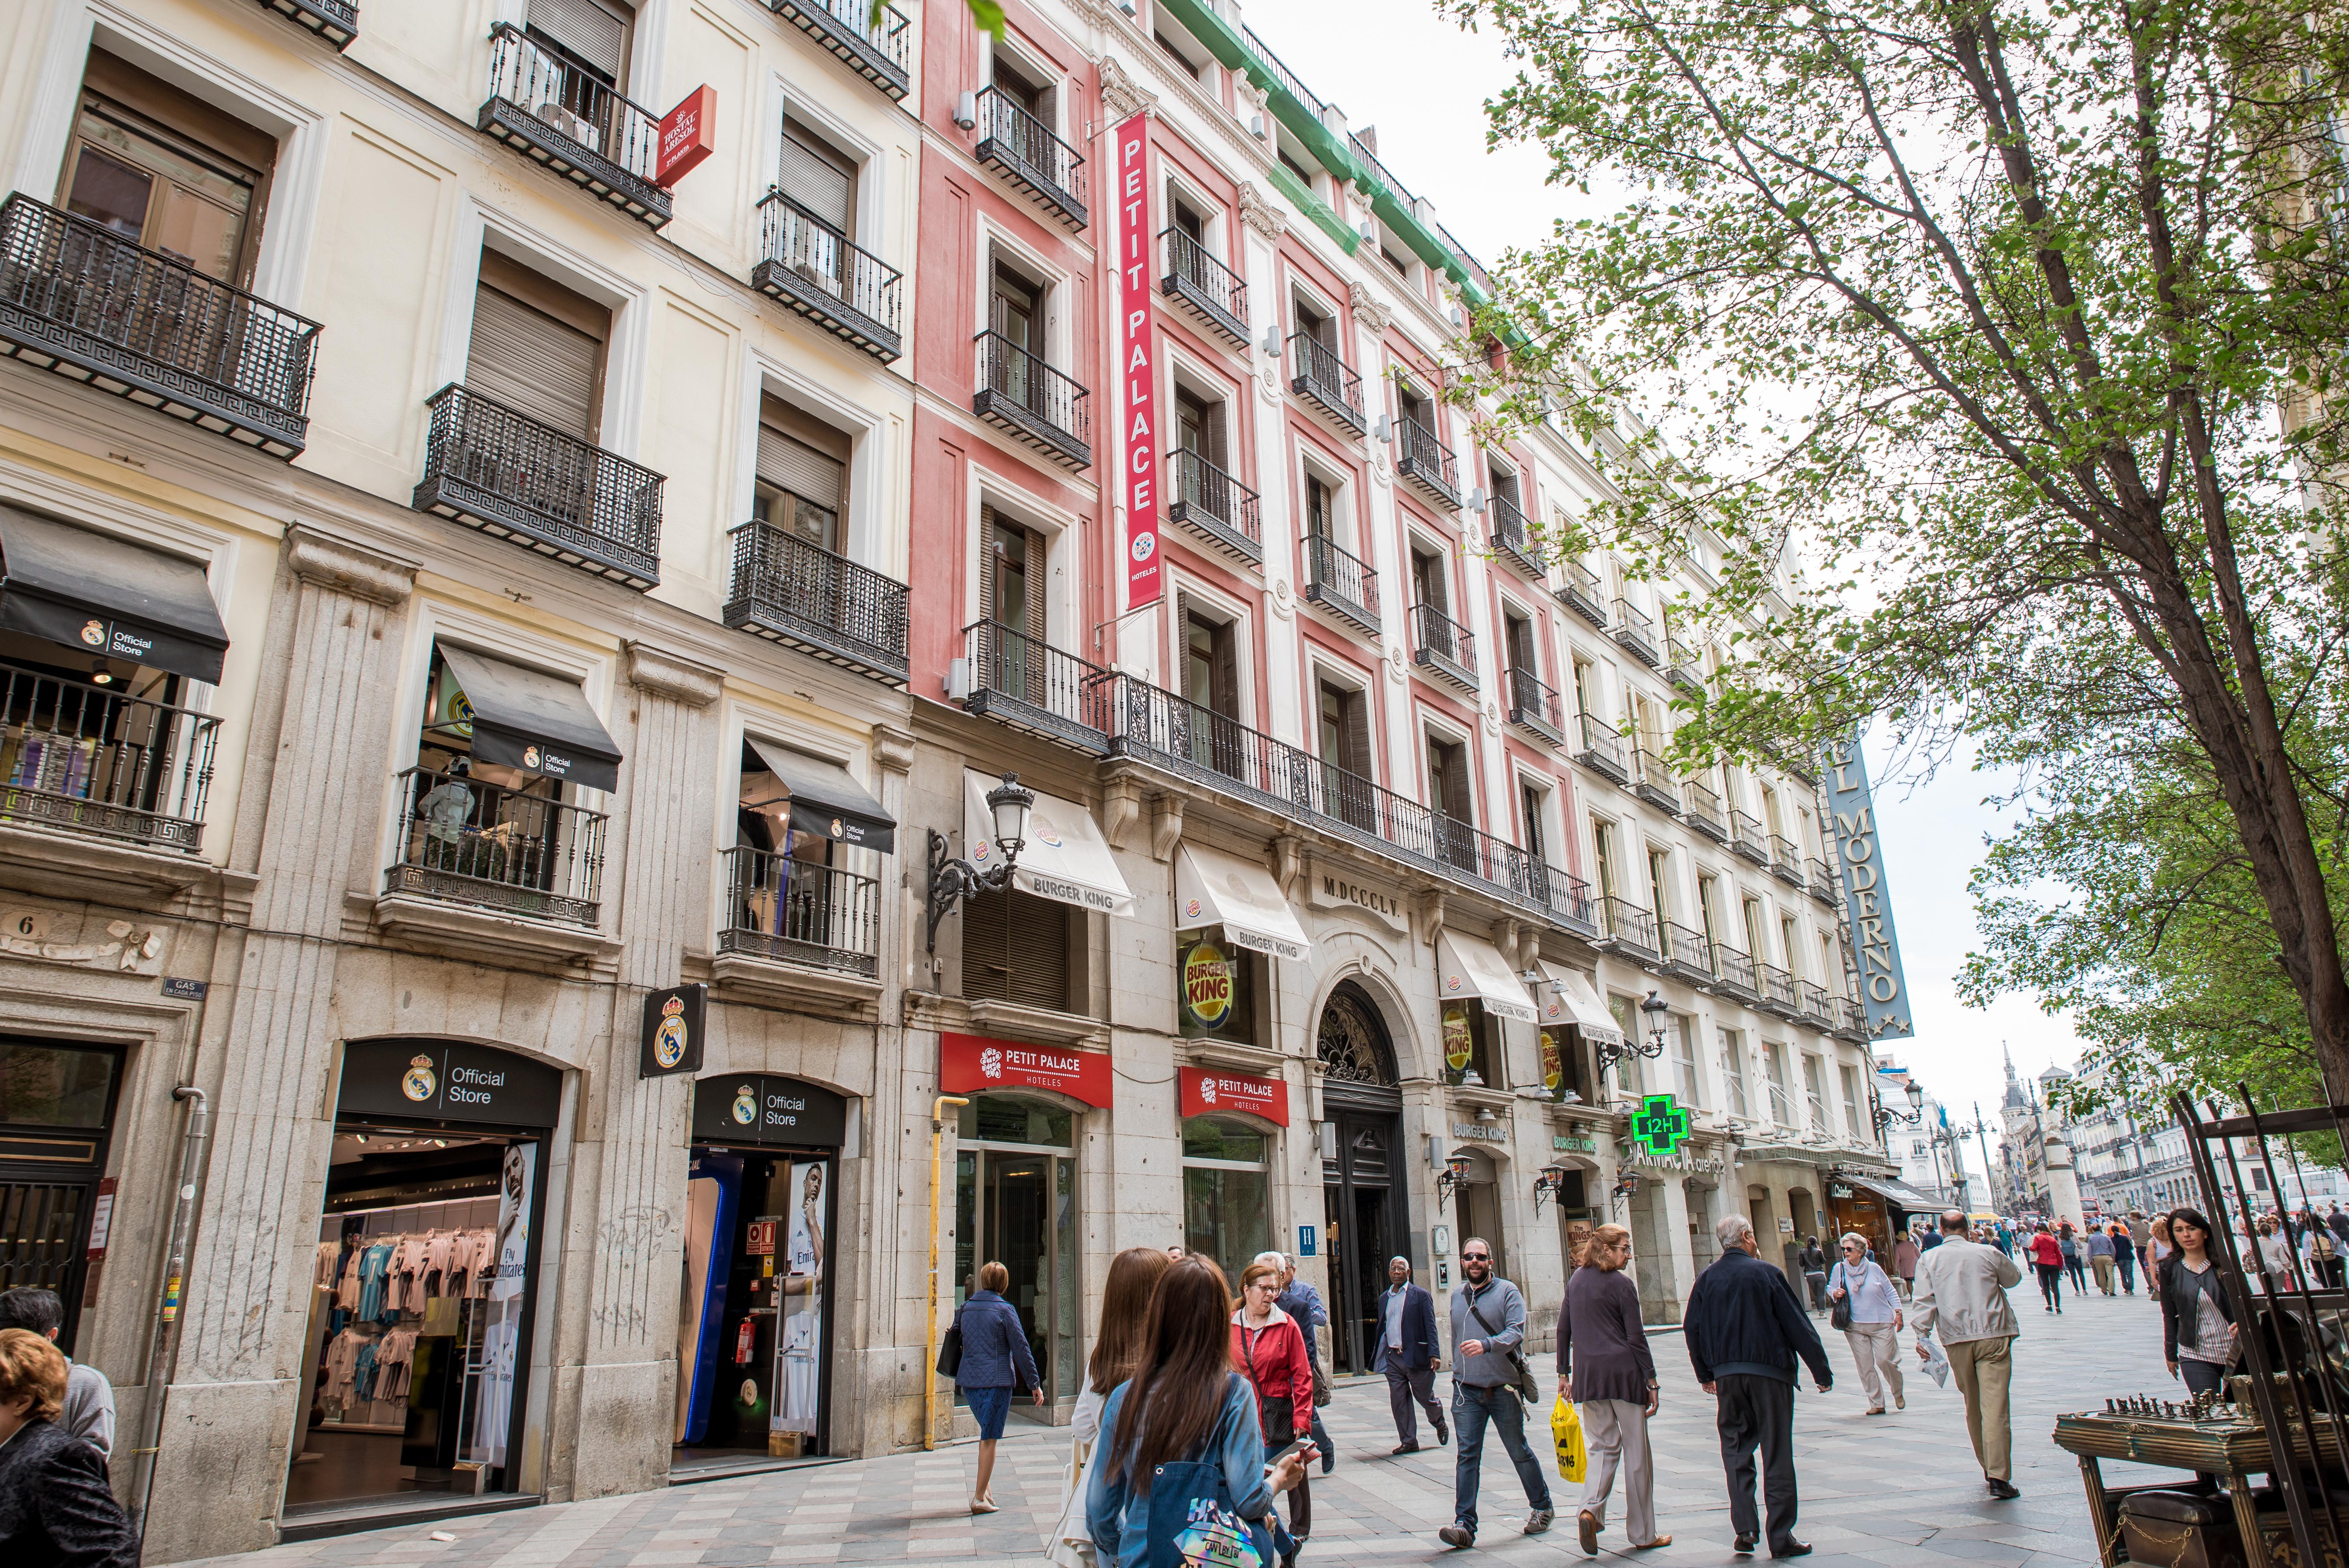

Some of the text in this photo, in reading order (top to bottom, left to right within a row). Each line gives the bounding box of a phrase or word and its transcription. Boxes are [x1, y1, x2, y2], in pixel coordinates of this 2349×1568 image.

[665, 114, 696, 145] HOSTAL
[664, 124, 696, 155] ARESOL
[671, 144, 690, 163] PLANTA
[1125, 139, 1150, 511] PETIT PALACE
[1132, 566, 1157, 581] HOTELES
[113, 641, 142, 656] Store
[114, 632, 152, 649] Official
[545, 755, 571, 767] Official
[545, 763, 565, 774] Store
[846, 825, 864, 835] Official
[846, 832, 861, 841] Store
[1037, 829, 1058, 839] KING
[975, 842, 987, 853] BURGER
[975, 848, 988, 858] KING
[1829, 739, 1897, 1002] EL MODERNO
[1034, 877, 1113, 909] BURGER KING
[1187, 901, 1199, 910] BURGER
[1188, 905, 1200, 914] KING
[19, 916, 33, 934] 6
[1239, 931, 1297, 957] BURGER KING
[1187, 962, 1227, 983] BURGER
[176, 981, 195, 990] GAS
[1188, 978, 1228, 1006] KING
[1449, 980, 1460, 988] KING
[1492, 1003, 1529, 1019] BURGER KING
[1587, 1027, 1616, 1042] BURGER KING
[1444, 1036, 1469, 1056] KING
[1006, 1050, 1080, 1071] PETIT PALACE
[1544, 1057, 1560, 1077] ING
[452, 1067, 504, 1086] Official
[1027, 1076, 1061, 1087] HOTELES
[449, 1086, 491, 1104] Store
[1219, 1079, 1272, 1097] PETIT PALACE
[767, 1095, 805, 1110] Official
[1234, 1101, 1259, 1110] HOTELES
[766, 1111, 796, 1125] Store
[1646, 1117, 1673, 1133] 12H
[1454, 1123, 1507, 1141] BURGER KING
[1553, 1136, 1597, 1152] BURGER KING
[1629, 1142, 1695, 1171] ARMACIA
[1835, 1184, 1852, 1198] Coimbra
[1303, 1228, 1311, 1245] H
[1568, 1230, 1591, 1241] KINGS
[505, 1248, 515, 1261] Fly
[798, 1249, 815, 1264] Emira
[417, 1257, 430, 1281] 7
[499, 1261, 526, 1278] mirates
[1205, 1542, 1218, 1553] CAN
[1222, 1545, 1230, 1555] BY
